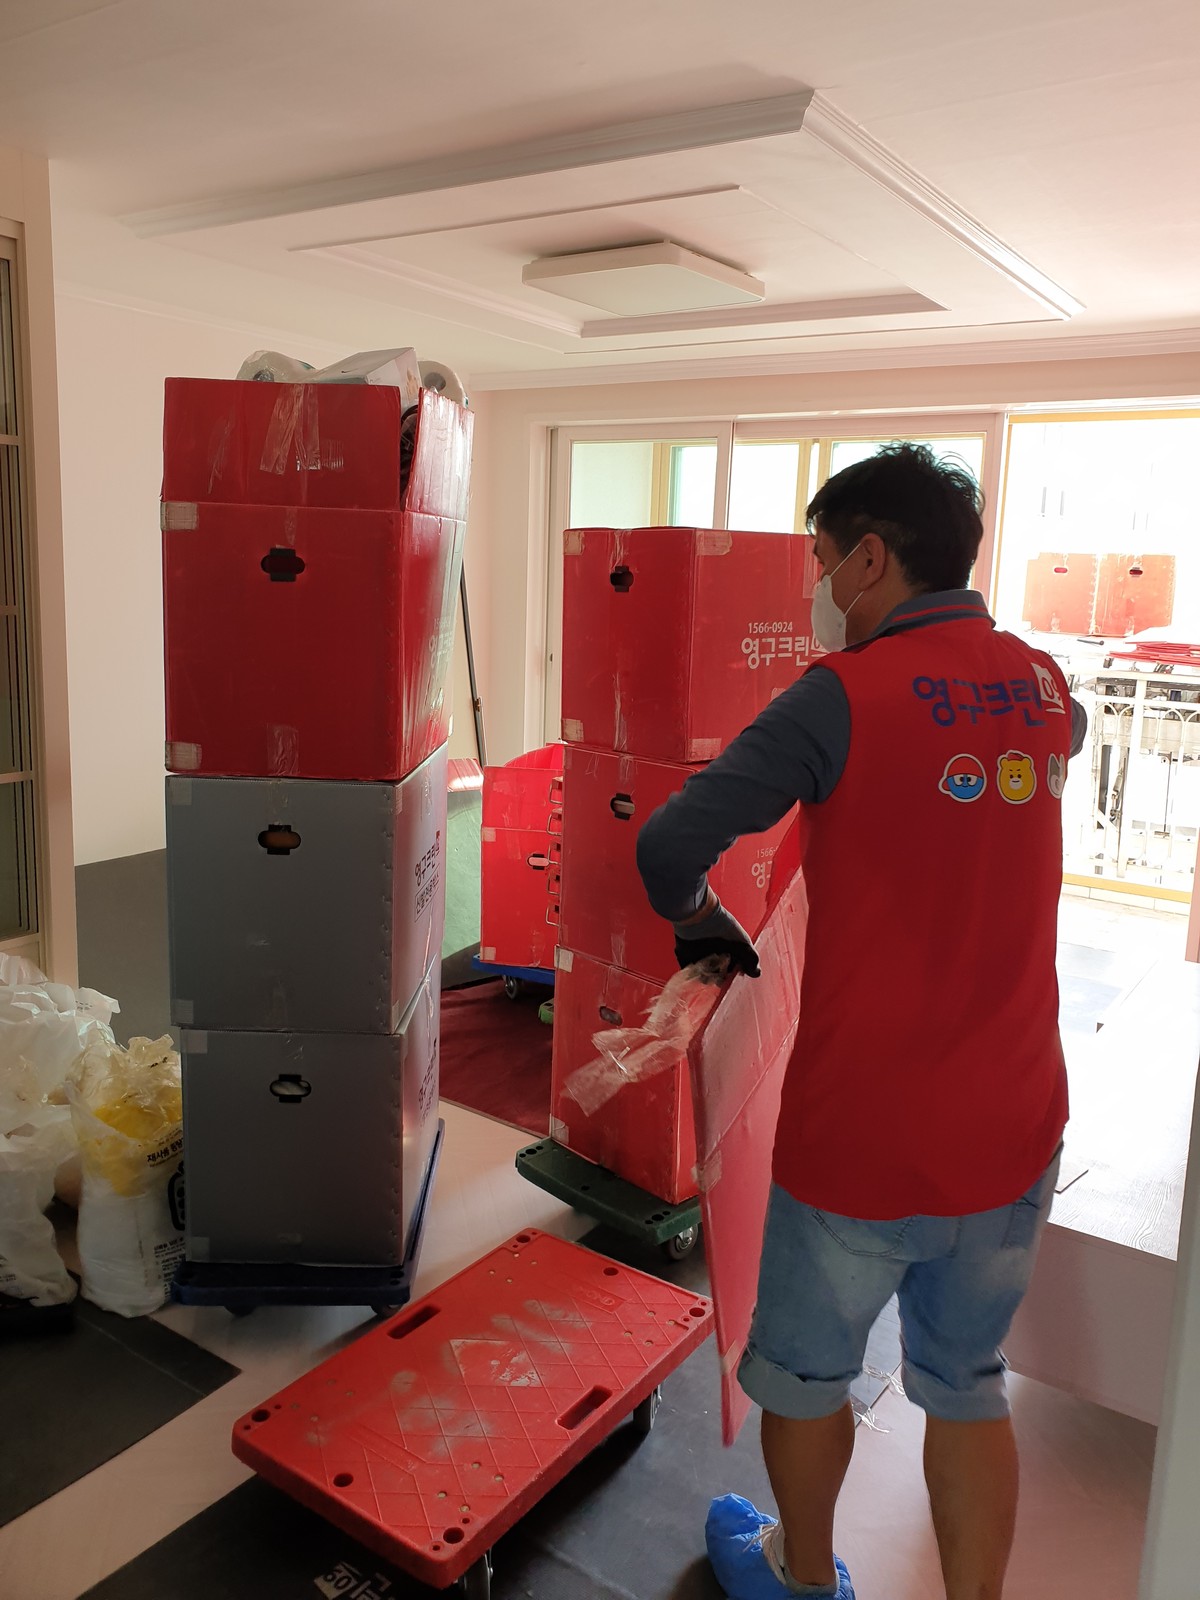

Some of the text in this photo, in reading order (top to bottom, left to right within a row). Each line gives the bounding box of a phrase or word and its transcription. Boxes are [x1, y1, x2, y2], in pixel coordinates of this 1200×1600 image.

[748, 621, 793, 634] 1566-0924
[741, 636, 810, 670] 영구크린
[912, 676, 1046, 727] 영구크린
[756, 846, 779, 858] 1566-
